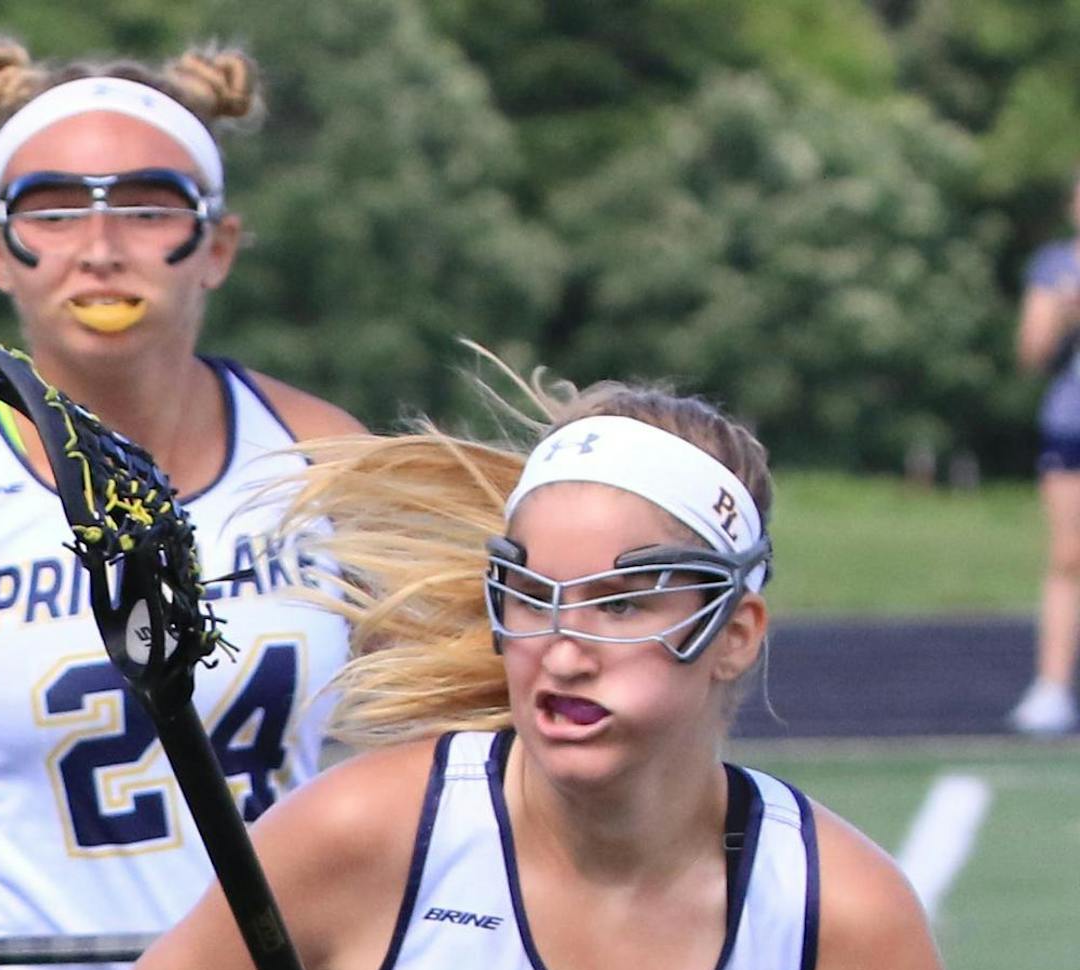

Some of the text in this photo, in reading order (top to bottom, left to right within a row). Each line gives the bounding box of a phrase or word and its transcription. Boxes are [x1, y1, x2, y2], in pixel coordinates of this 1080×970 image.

[712, 486, 738, 541] PL
[37, 637, 303, 852] 24
[423, 907, 504, 931] BRINE
